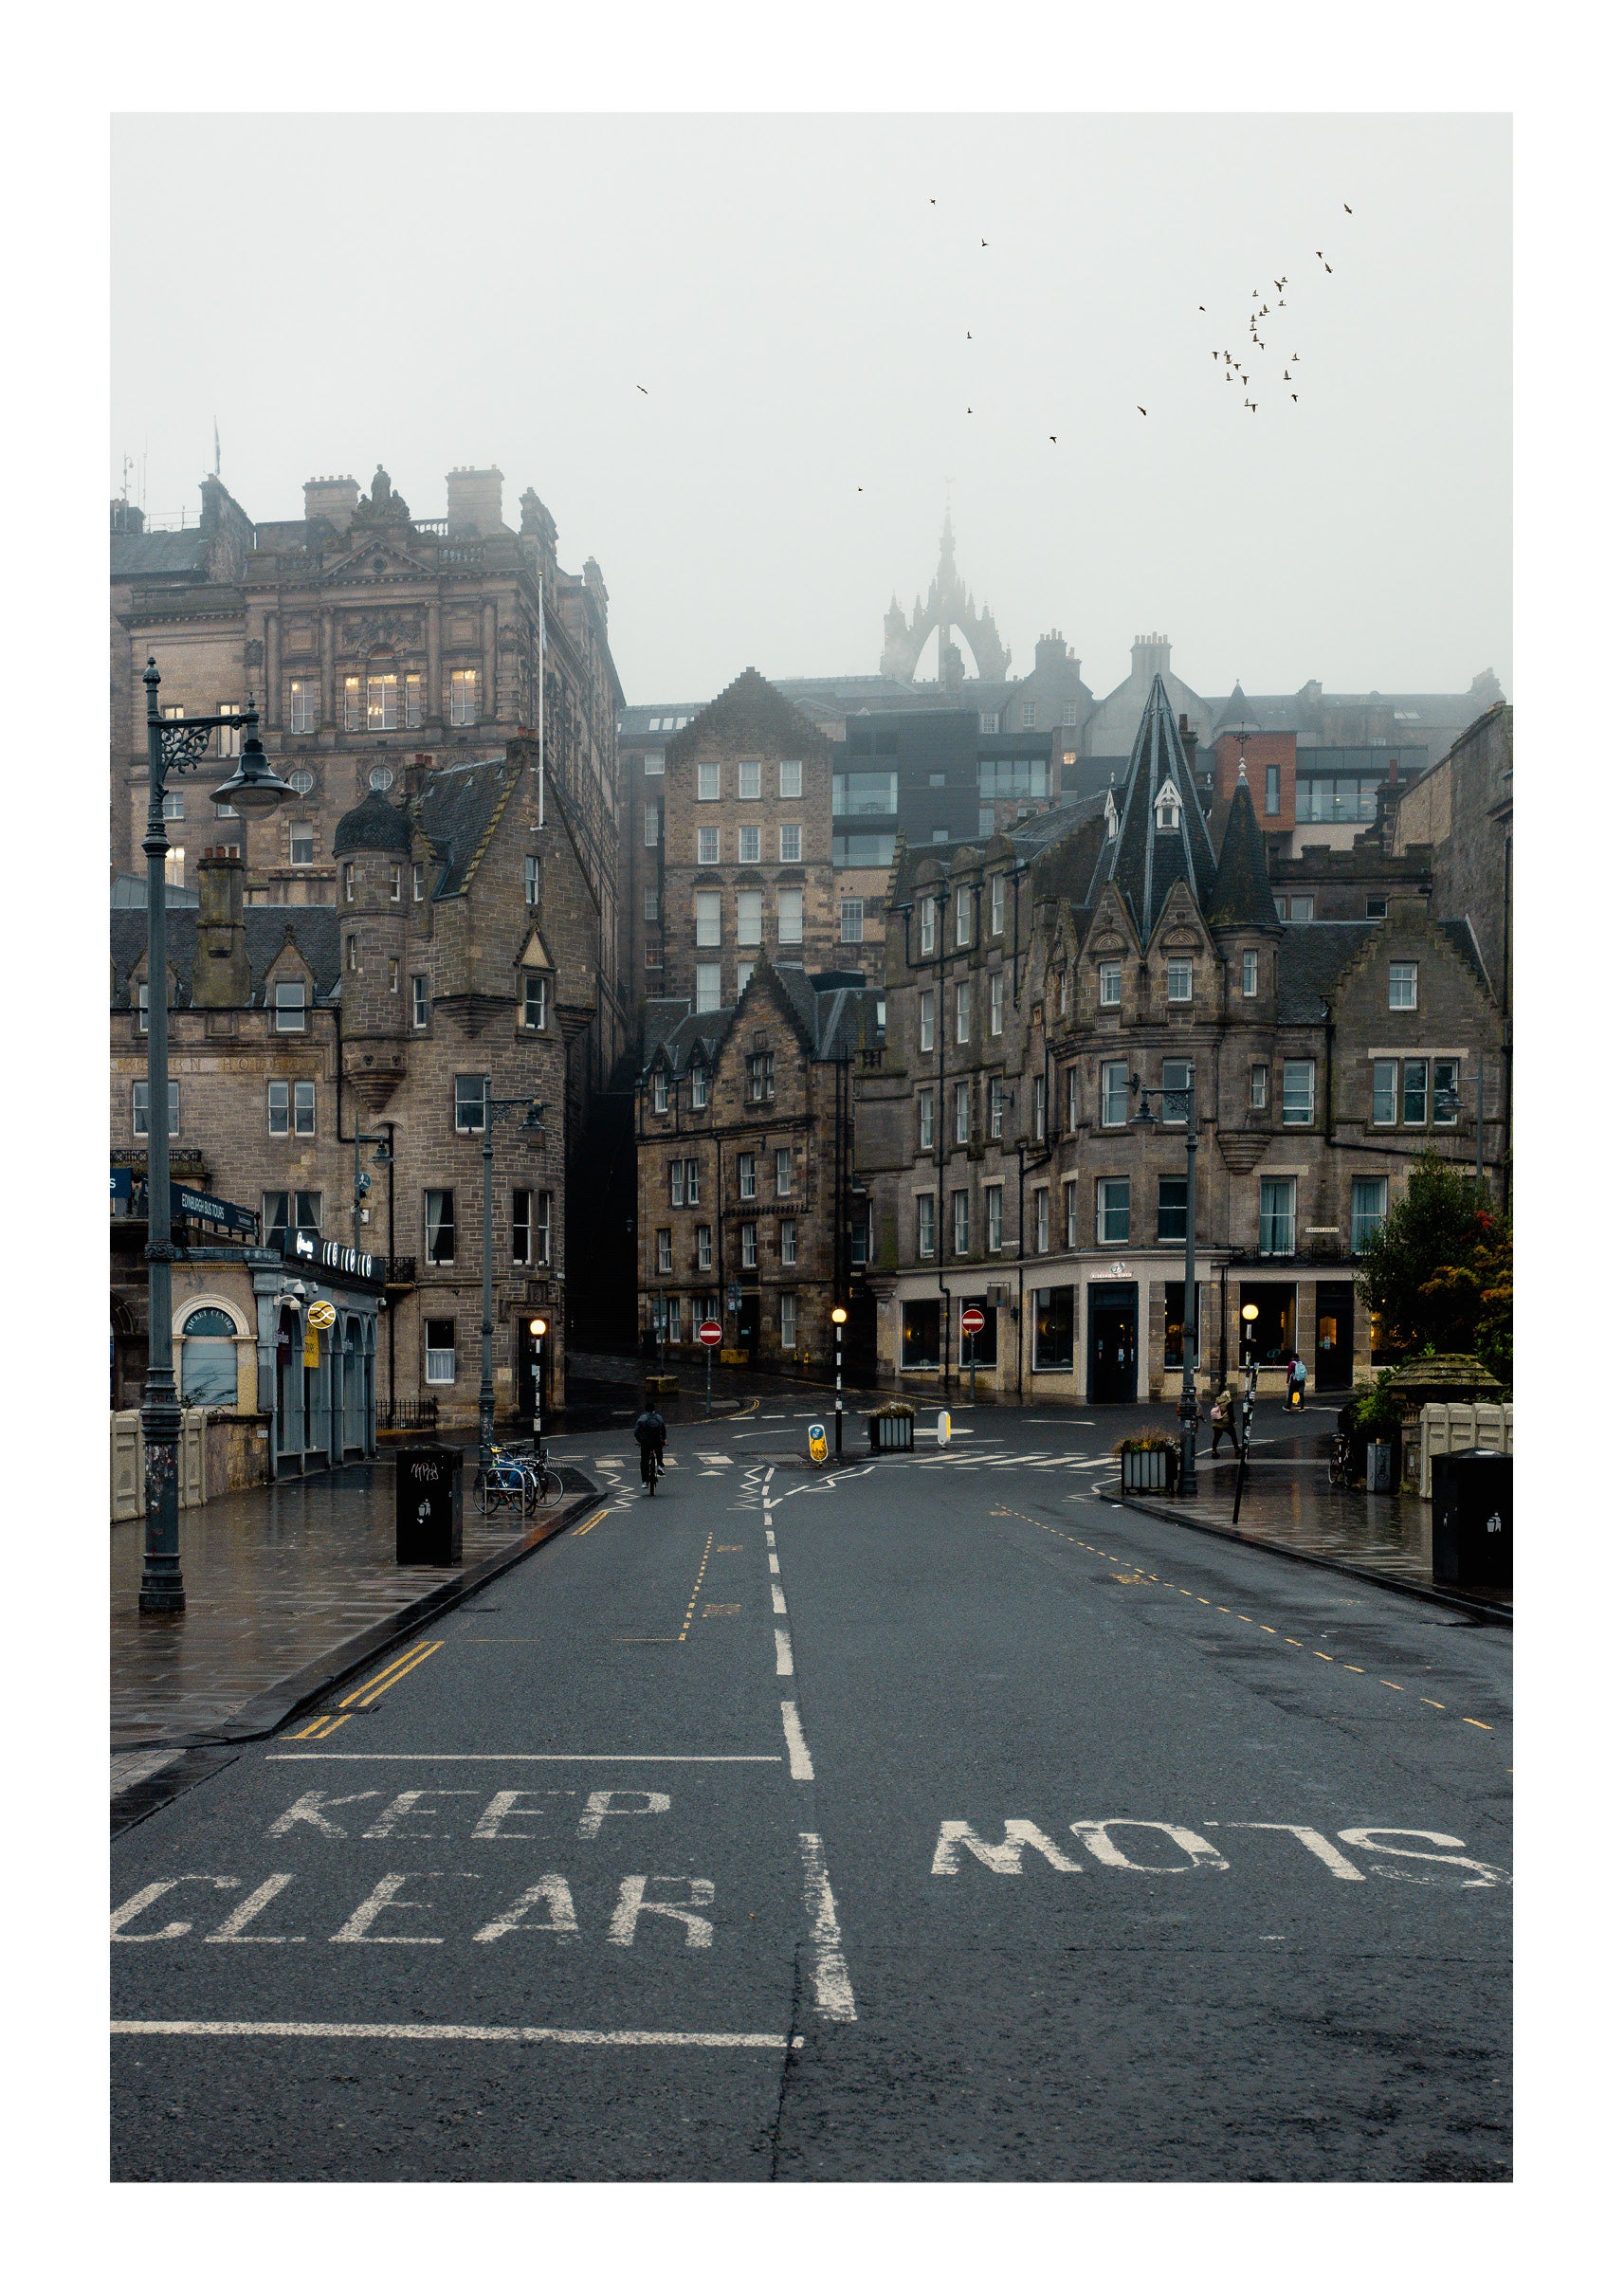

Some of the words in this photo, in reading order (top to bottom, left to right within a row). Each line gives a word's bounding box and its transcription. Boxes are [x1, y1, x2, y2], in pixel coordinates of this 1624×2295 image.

[181, 1193, 205, 1213] EDINBURGH
[204, 1200, 212, 1215] BUS
[211, 1203, 225, 1220] TOURS
[186, 1310, 208, 1331] TICKET
[210, 1309, 234, 1330] CENTRE
[265, 1790, 672, 1839] KEEP
[930, 1818, 1513, 1887] SLOW
[110, 1873, 716, 1949] CLEAR
